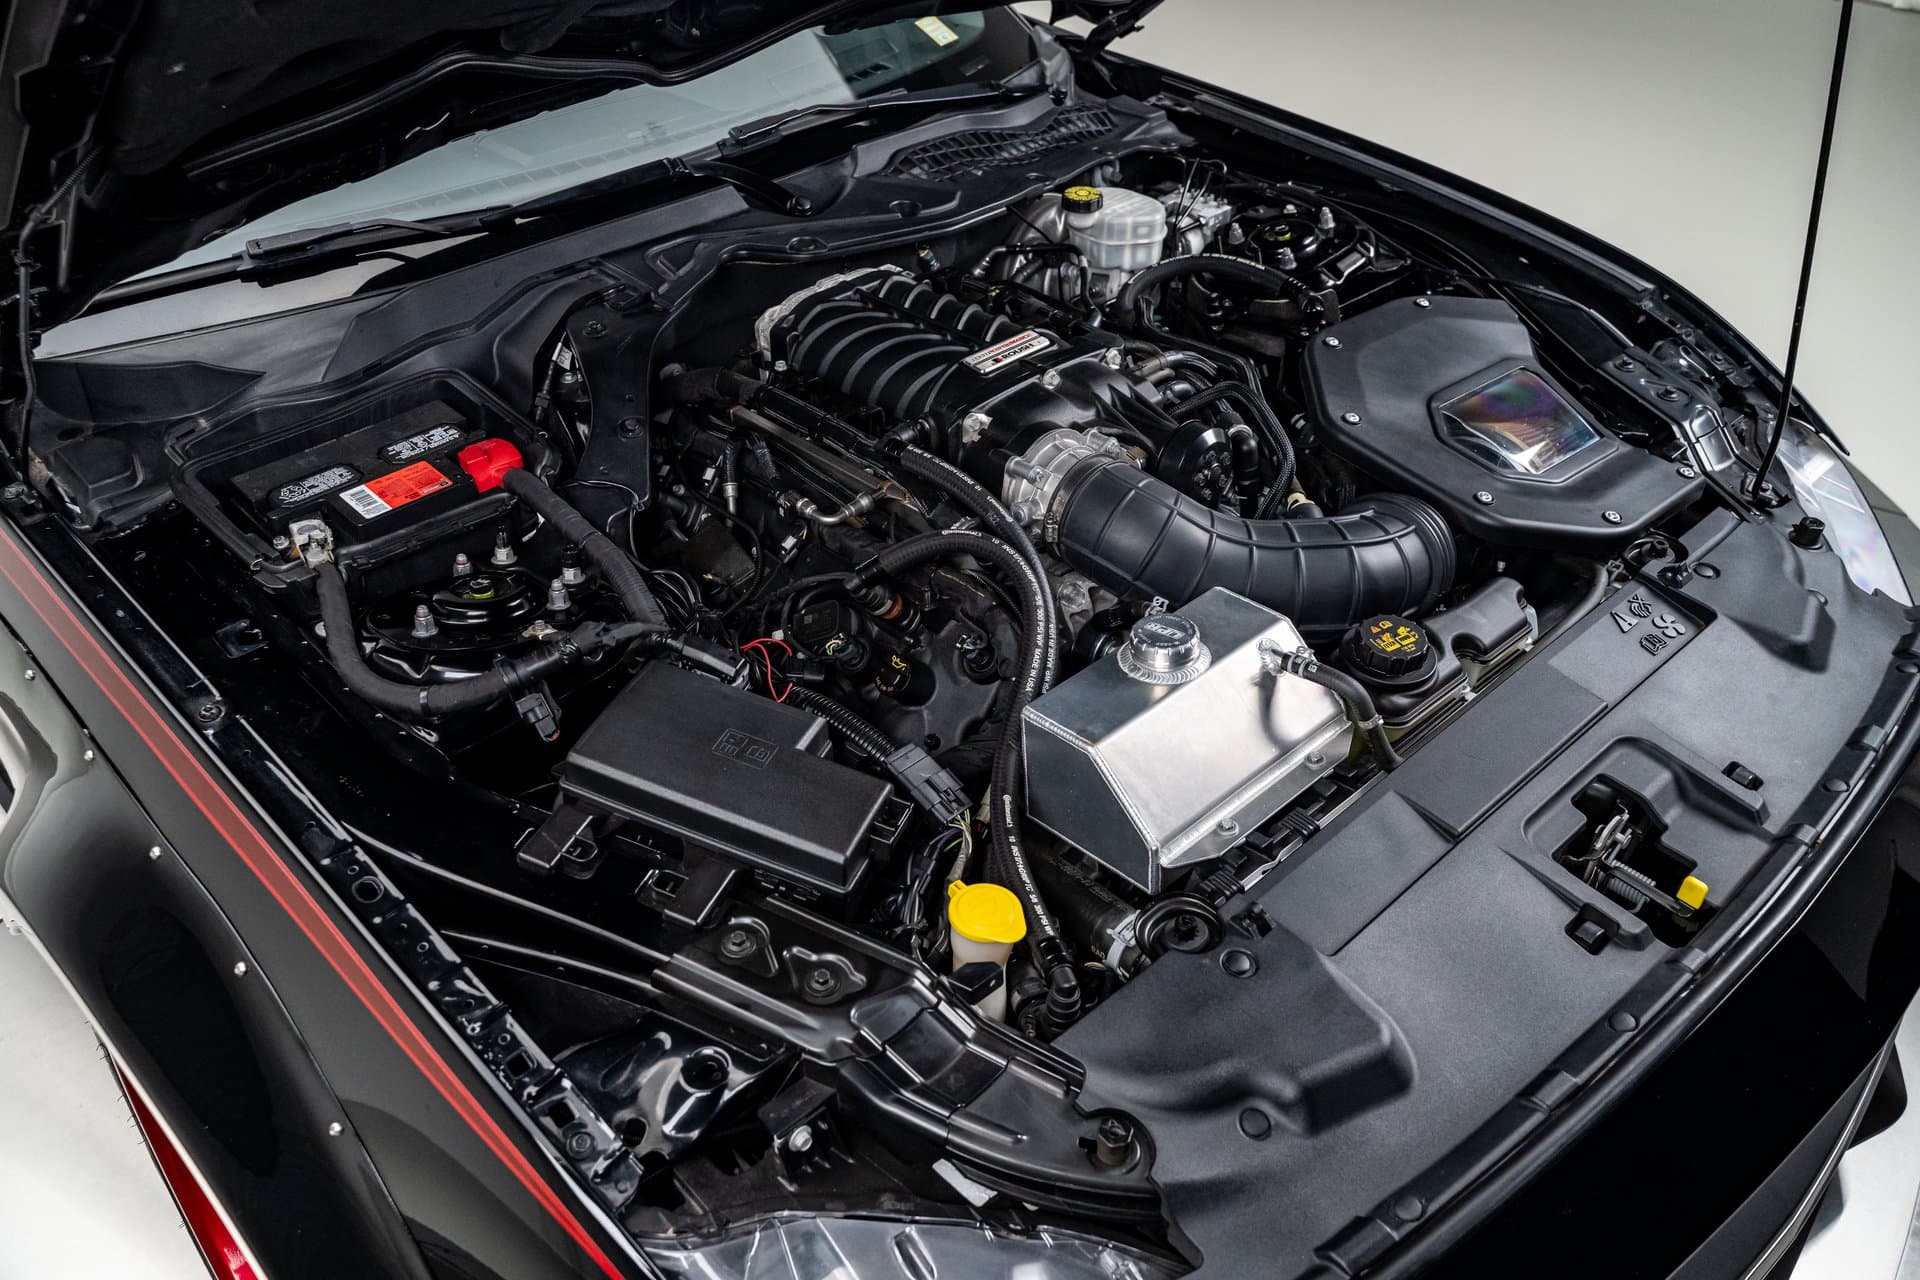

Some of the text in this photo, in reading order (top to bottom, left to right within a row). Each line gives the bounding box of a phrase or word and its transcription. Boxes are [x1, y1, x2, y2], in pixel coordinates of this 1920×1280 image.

[1001, 343, 1035, 359] ROUSH
[1036, 621, 1045, 633] PSI
[1032, 648, 1043, 669] MADE
[1046, 647, 1056, 668] MADE
[1024, 676, 1036, 692] USA
